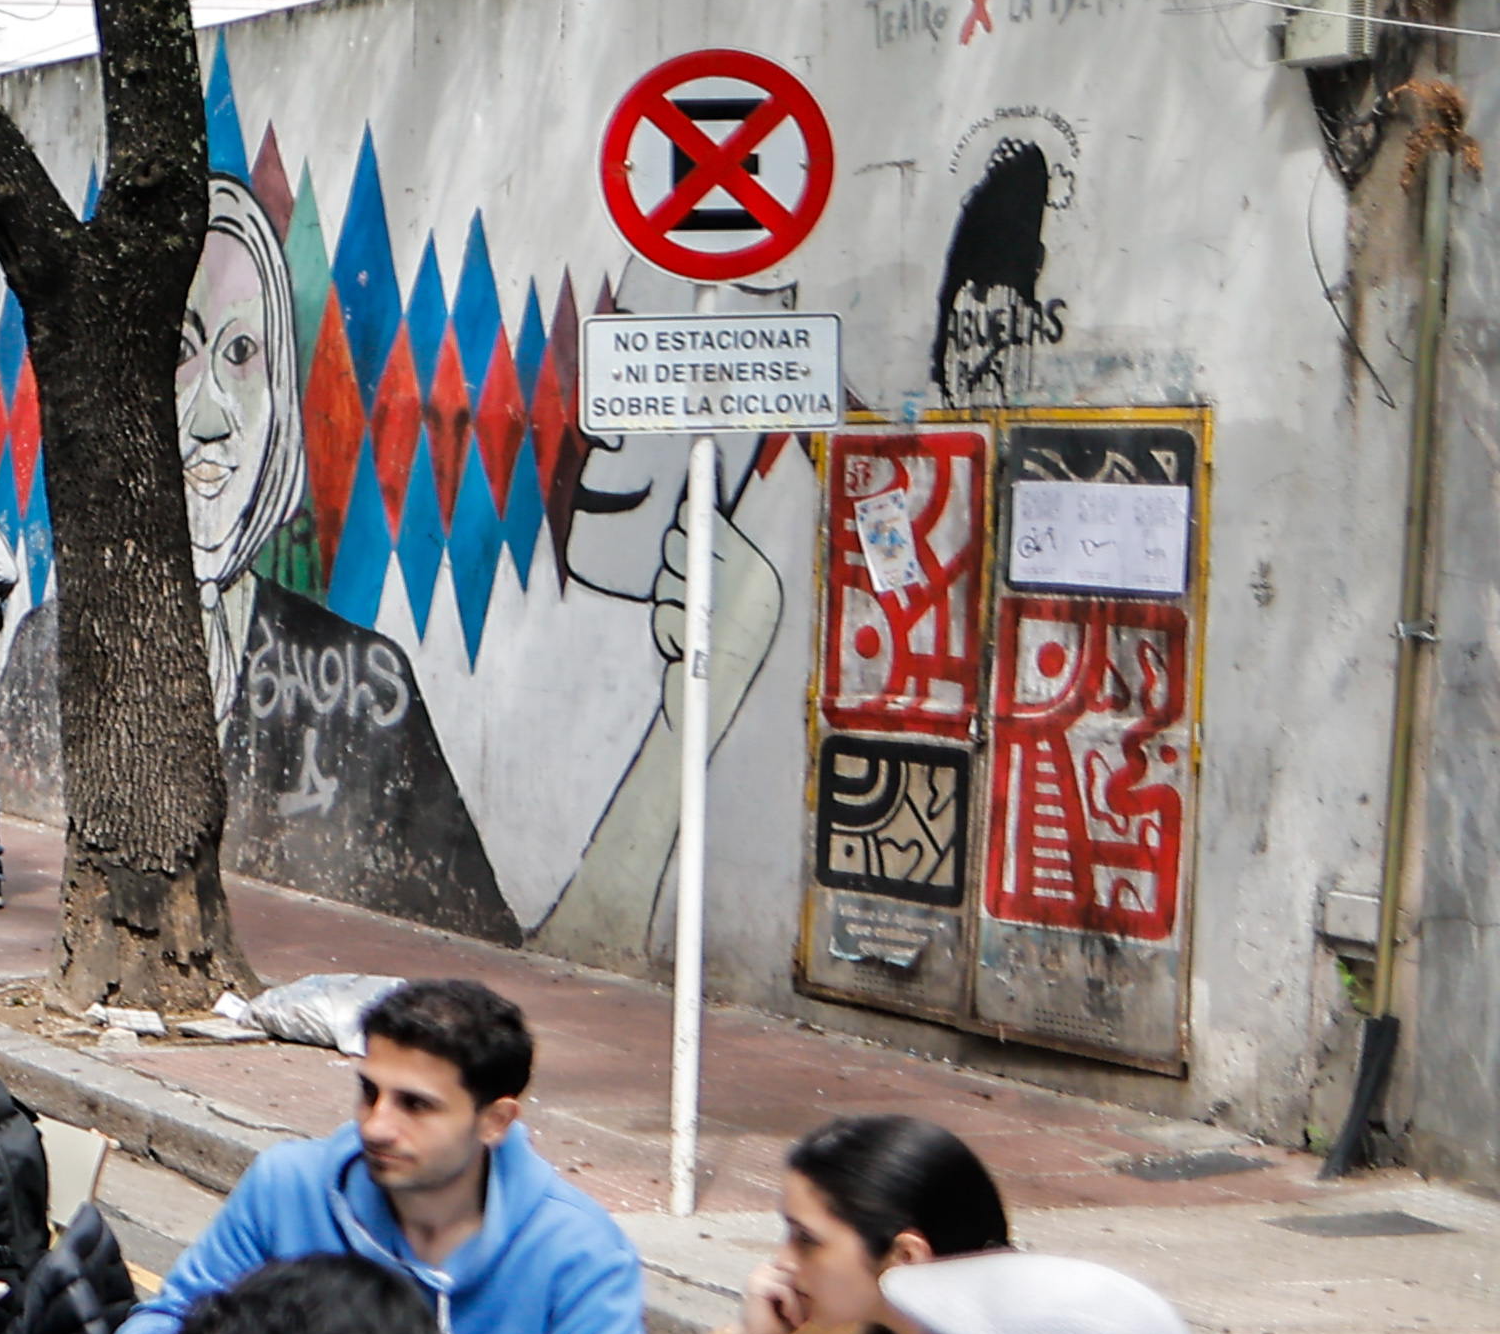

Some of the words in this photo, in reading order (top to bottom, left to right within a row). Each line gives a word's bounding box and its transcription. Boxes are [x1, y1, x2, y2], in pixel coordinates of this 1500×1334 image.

[947, 298, 1069, 352] ABUELAS
[614, 331, 648, 352] NO
[656, 329, 810, 351] ESTACIONAR
[626, 364, 648, 383] NI
[655, 361, 800, 383] DETENERSE
[592, 396, 676, 417] SOBRE
[683, 395, 715, 416] LA
[720, 393, 833, 415] CICLOVIA
